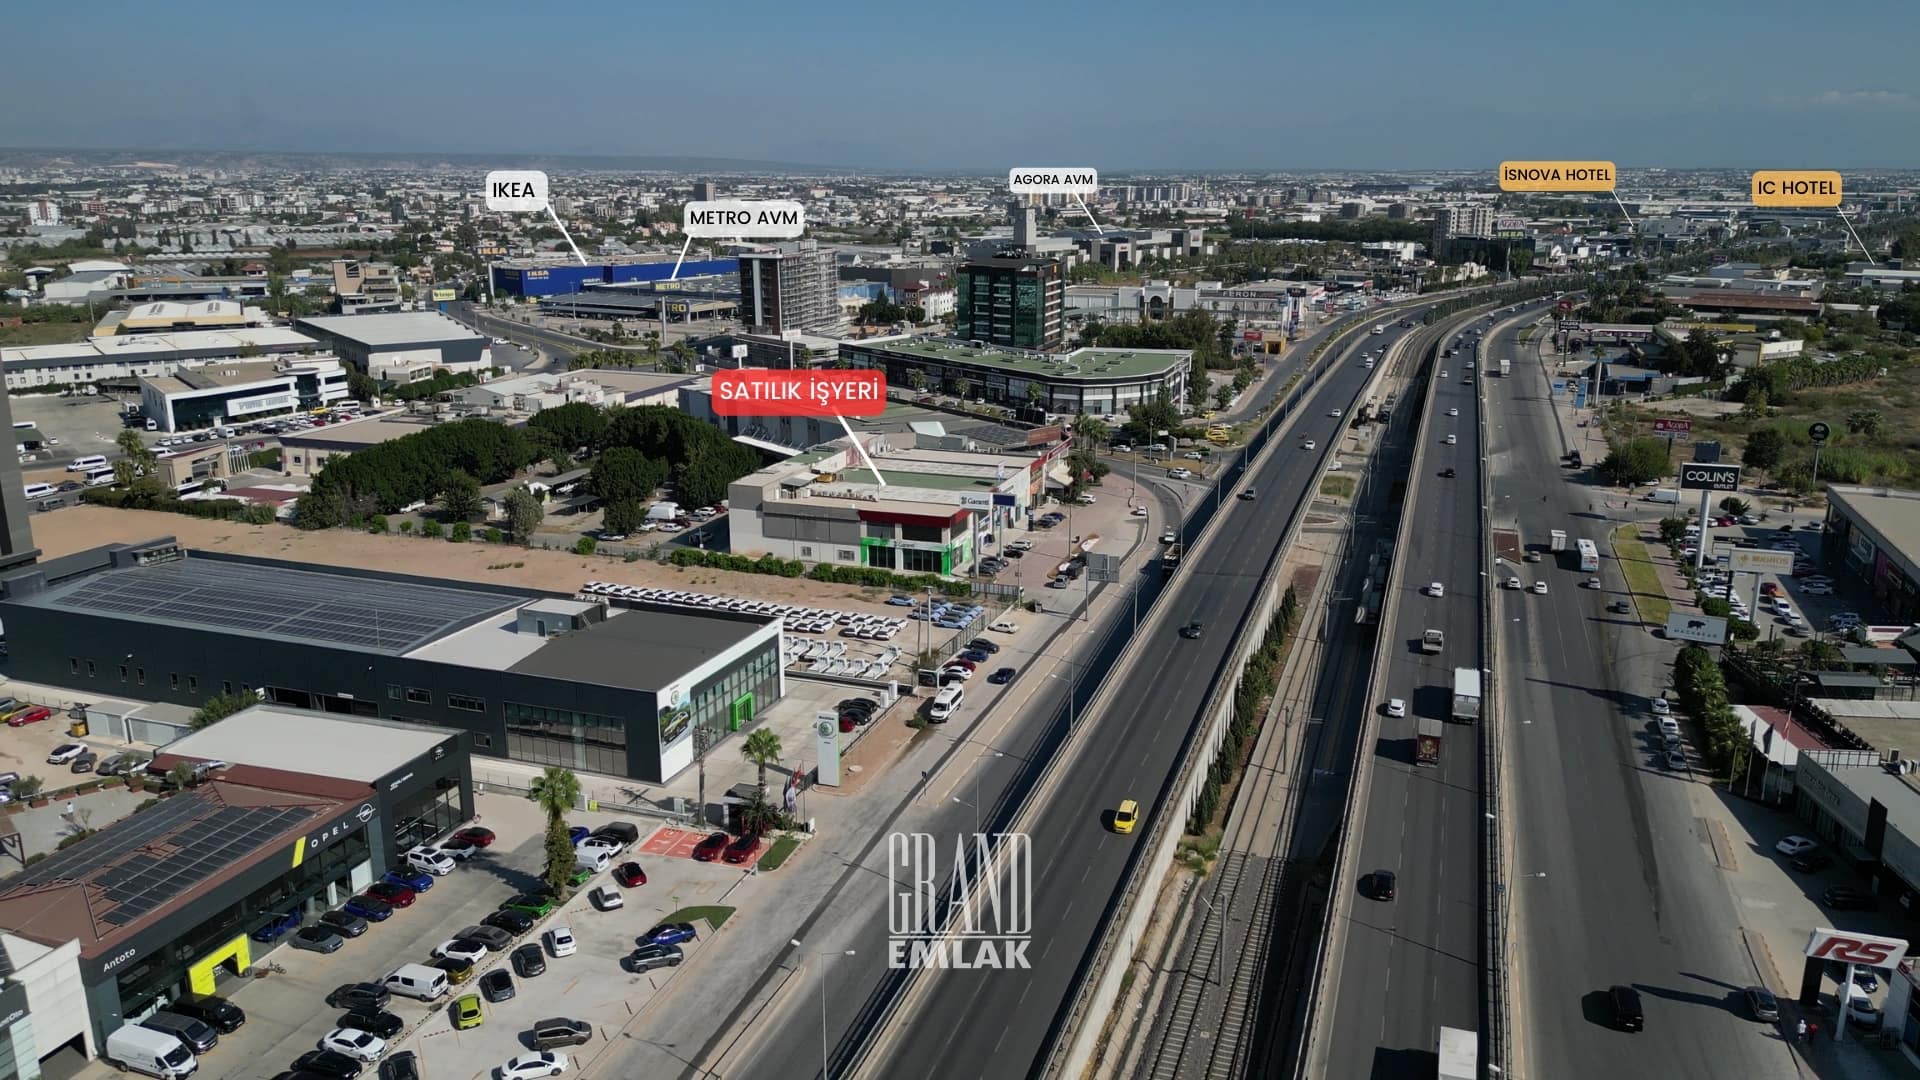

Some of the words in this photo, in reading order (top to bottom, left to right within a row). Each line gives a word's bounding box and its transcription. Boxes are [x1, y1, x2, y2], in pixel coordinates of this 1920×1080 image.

[477, 247, 507, 255] IKEA
[1686, 470, 1736, 484] COLIN'S
[310, 821, 350, 848] OPEL
[103, 948, 136, 973] Antoto
[1813, 936, 1897, 965] RS
